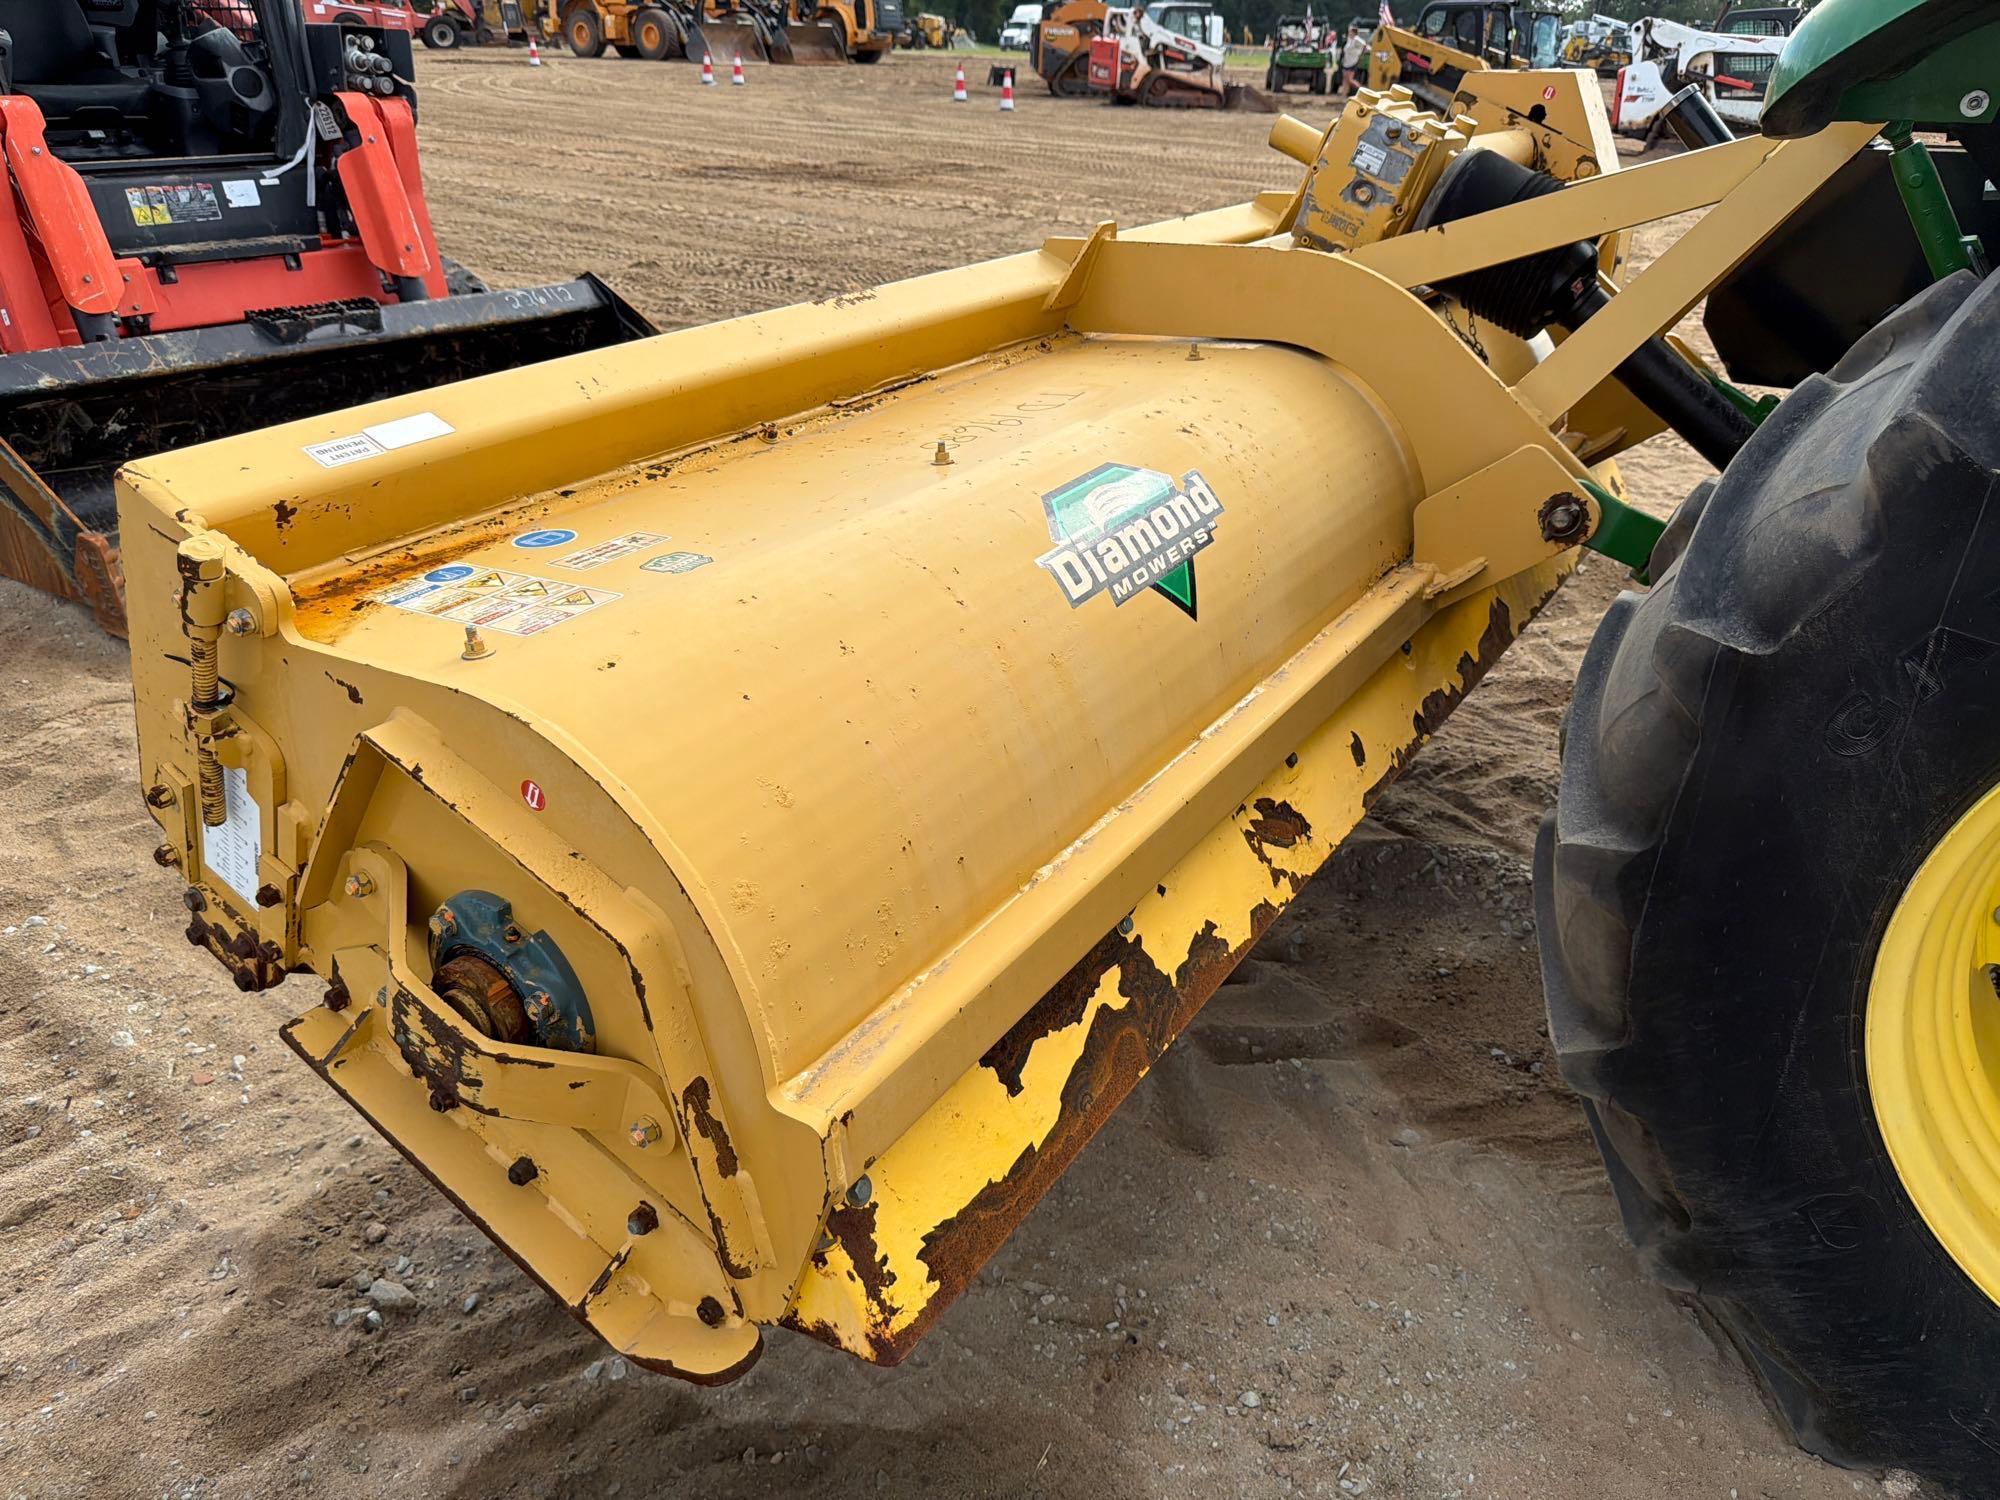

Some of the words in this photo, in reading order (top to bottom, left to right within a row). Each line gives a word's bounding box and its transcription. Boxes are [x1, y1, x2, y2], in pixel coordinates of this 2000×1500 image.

[318, 106, 338, 135] 226112
[504, 286, 575, 309] 226112
[315, 439, 366, 455] PENDING
[330, 446, 371, 460] PATENT
[1049, 473, 1220, 600] Diamond
